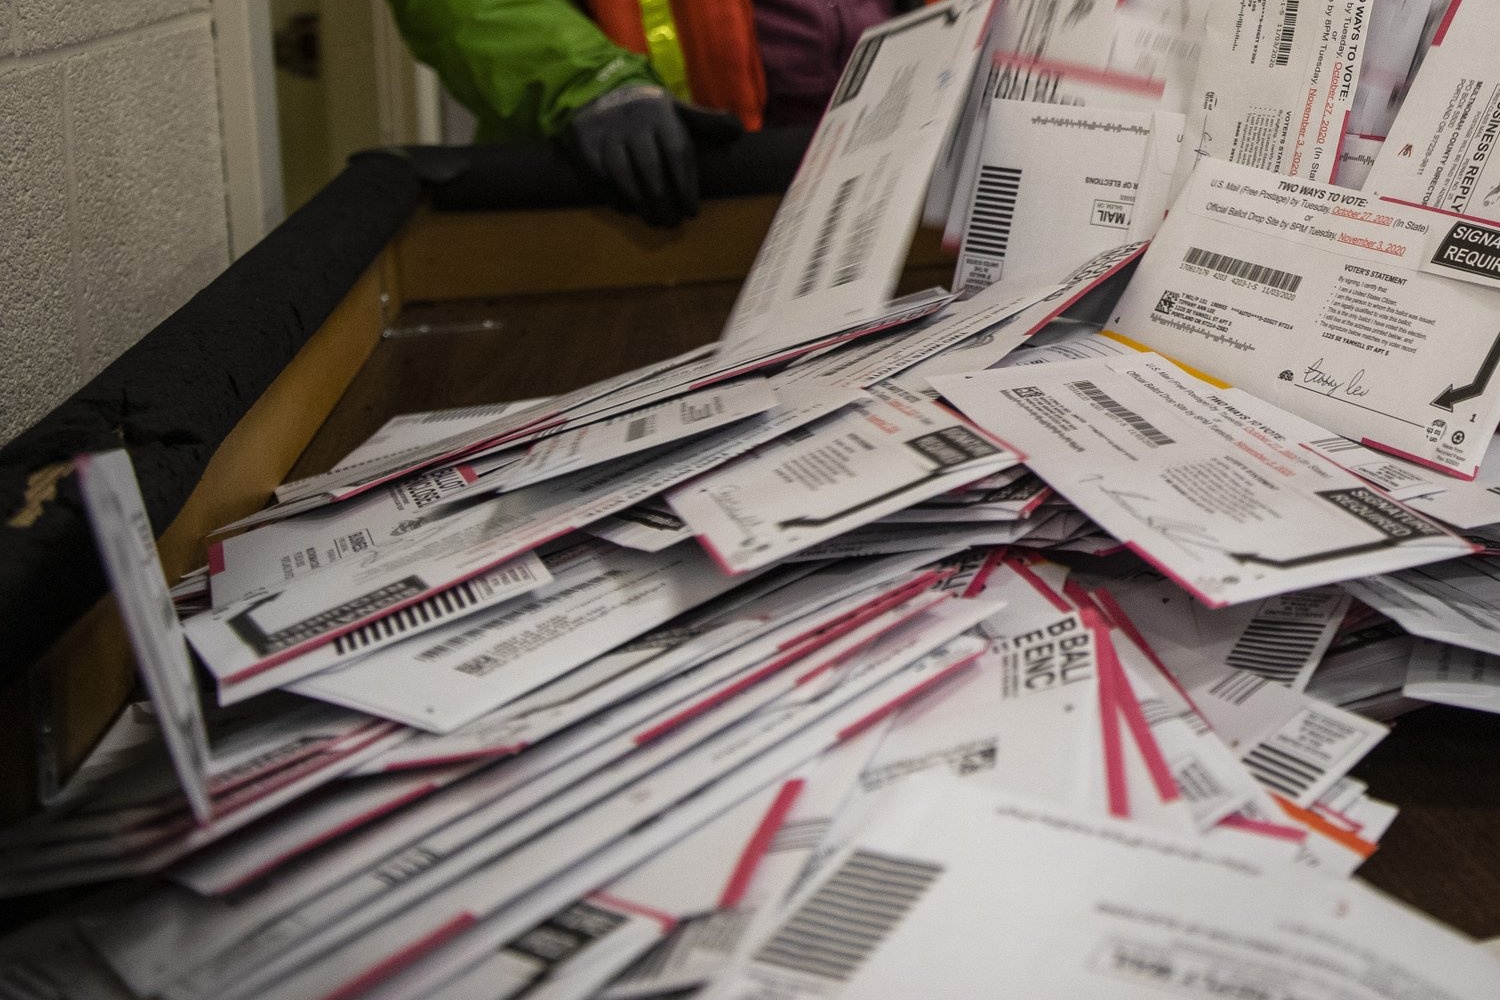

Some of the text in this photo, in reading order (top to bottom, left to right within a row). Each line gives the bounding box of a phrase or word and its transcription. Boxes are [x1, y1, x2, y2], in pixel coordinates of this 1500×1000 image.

[1325, 5, 1334, 17] by
[1344, 2, 1354, 15] by
[1321, 18, 1333, 42] 8PM
[1331, 31, 1338, 41] or
[1350, 5, 1365, 43] WAYS
[1268, 23, 1282, 69] 11/03/2020
[1336, 16, 1352, 59] Tuesday,
[1311, 45, 1328, 86] Tuesday,
[1347, 49, 1358, 61] TO
[1327, 61, 1343, 98] October
[1338, 64, 1353, 102] VOTE:
[1323, 100, 1334, 121] 27,
[1443, 79, 1466, 120] PORTLAND
[1457, 93, 1469, 111] BOX
[1457, 81, 1484, 132] MULTNOMAH
[1300, 88, 1318, 137] November
[1279, 110, 1292, 144] VOTER'S
[1316, 120, 1329, 145] 2020
[1436, 121, 1446, 133] OR
[1297, 139, 1305, 152] 3,
[1314, 146, 1324, 160] (In
[1440, 132, 1459, 166] COUNTY
[1289, 152, 1301, 177] 2020
[1085, 176, 1121, 189] ELECTIONS
[1277, 180, 1369, 208] TWO WAYS TO VOTE:
[1451, 165, 1479, 213] REPLY
[1097, 210, 1126, 225] MAIL
[1209, 179, 1429, 235] U.S. Mail (Free Postage) by Tuesday, October 27, 2020 (In State)
[1304, 213, 1313, 222] or
[1205, 202, 1228, 213] Official
[1227, 208, 1249, 219] Ballot
[1247, 212, 1265, 225] Drop
[1265, 215, 1280, 226] Site
[1280, 219, 1290, 231] by
[1308, 224, 1337, 241] Tuesday,
[1337, 232, 1376, 250] November
[1374, 240, 1384, 252] 3,
[1382, 242, 1406, 257] 2020
[1212, 272, 1228, 281] 4203
[1231, 277, 1258, 291] 4203-1-S
[1261, 286, 1296, 301] 11/03/2020
[1344, 264, 1407, 286] VOTER'S STATEMENT
[1197, 304, 1206, 312] ANN
[1373, 345, 1385, 354] APT
[1469, 413, 1477, 423] 1
[1330, 494, 1412, 537] REQUIRED
[1351, 490, 1436, 534] SIGNATURE
